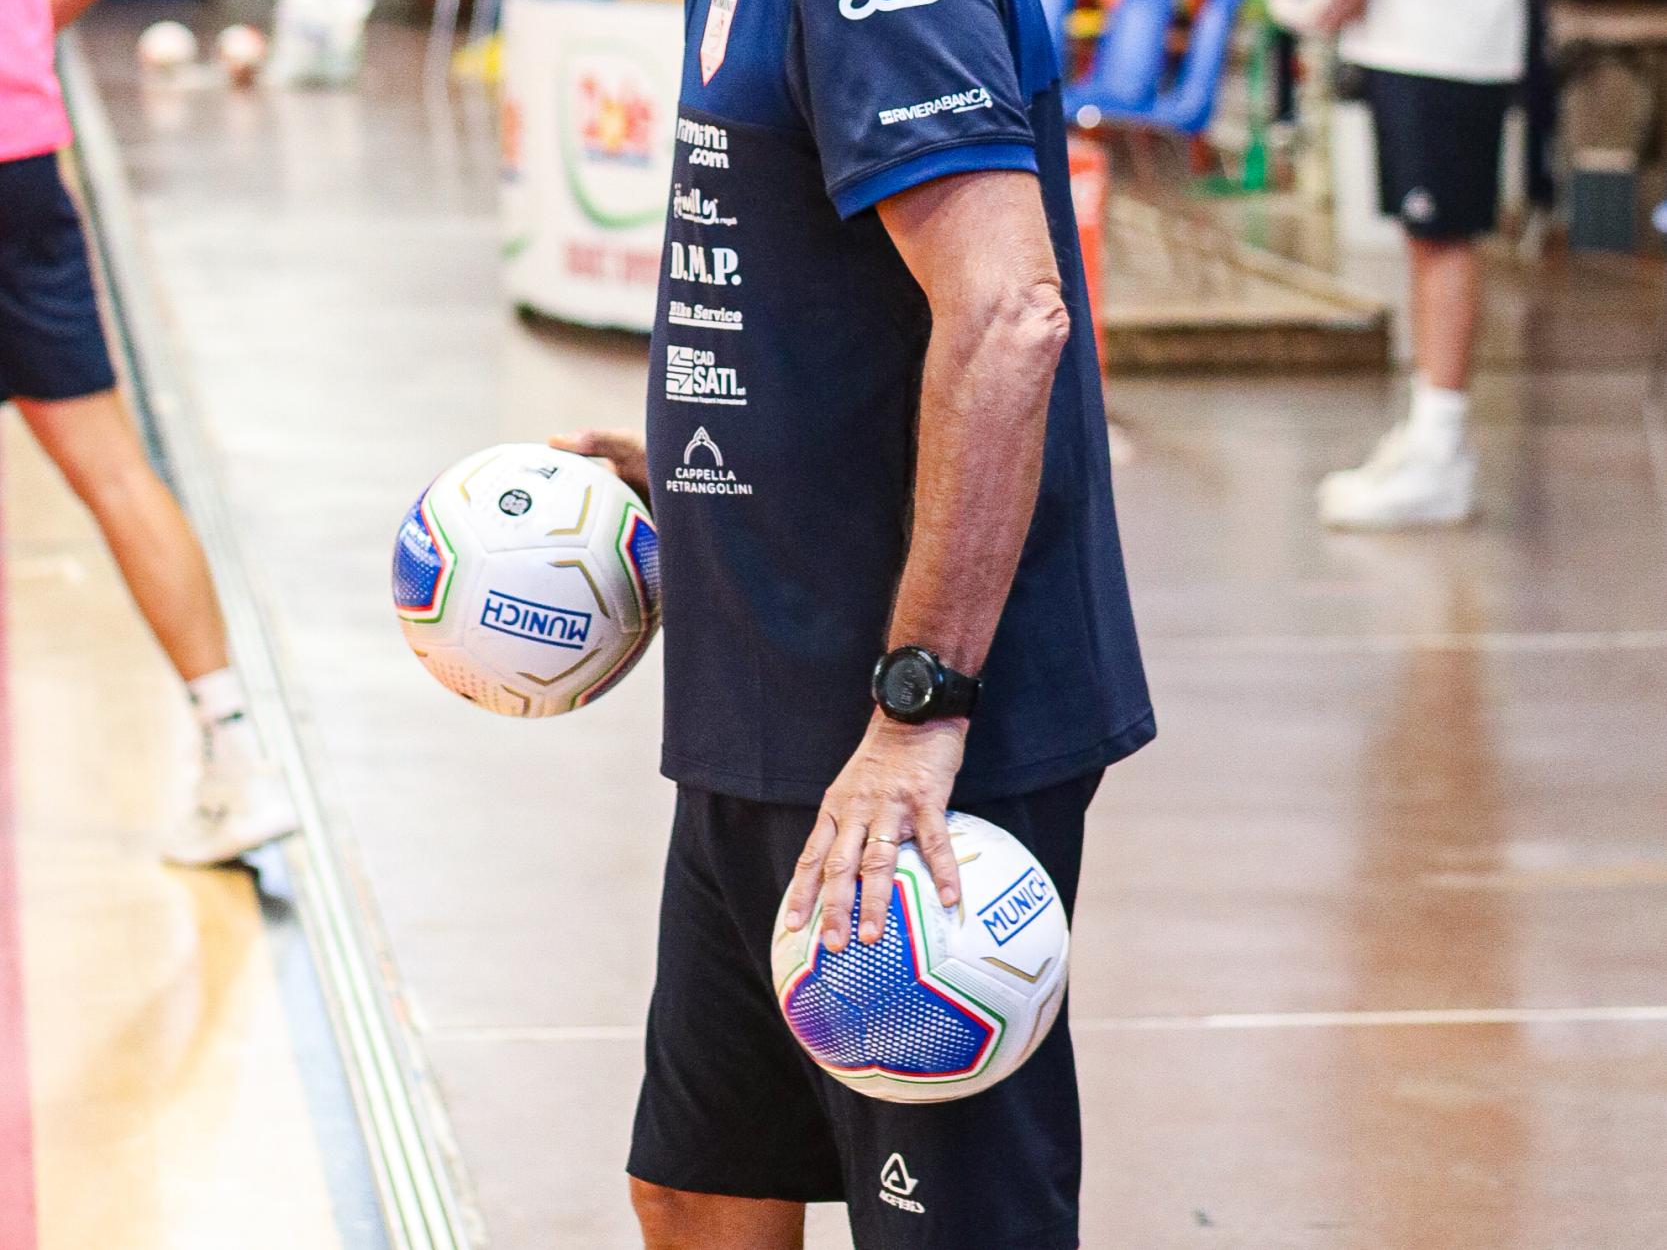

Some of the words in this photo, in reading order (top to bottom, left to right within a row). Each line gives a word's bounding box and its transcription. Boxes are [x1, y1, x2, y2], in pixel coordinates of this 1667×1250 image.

[892, 87, 991, 123] RIVIERABANCA
[689, 148, 729, 168] .com
[670, 241, 742, 286] D.M.P.
[694, 304, 742, 322] Service
[693, 350, 715, 366] CAD
[693, 366, 736, 396] SATI
[675, 467, 736, 481] CAPPELLA
[666, 480, 753, 495] PETRANGOLINI
[481, 597, 591, 643] MUNICH
[982, 874, 1049, 934] MUNICH
